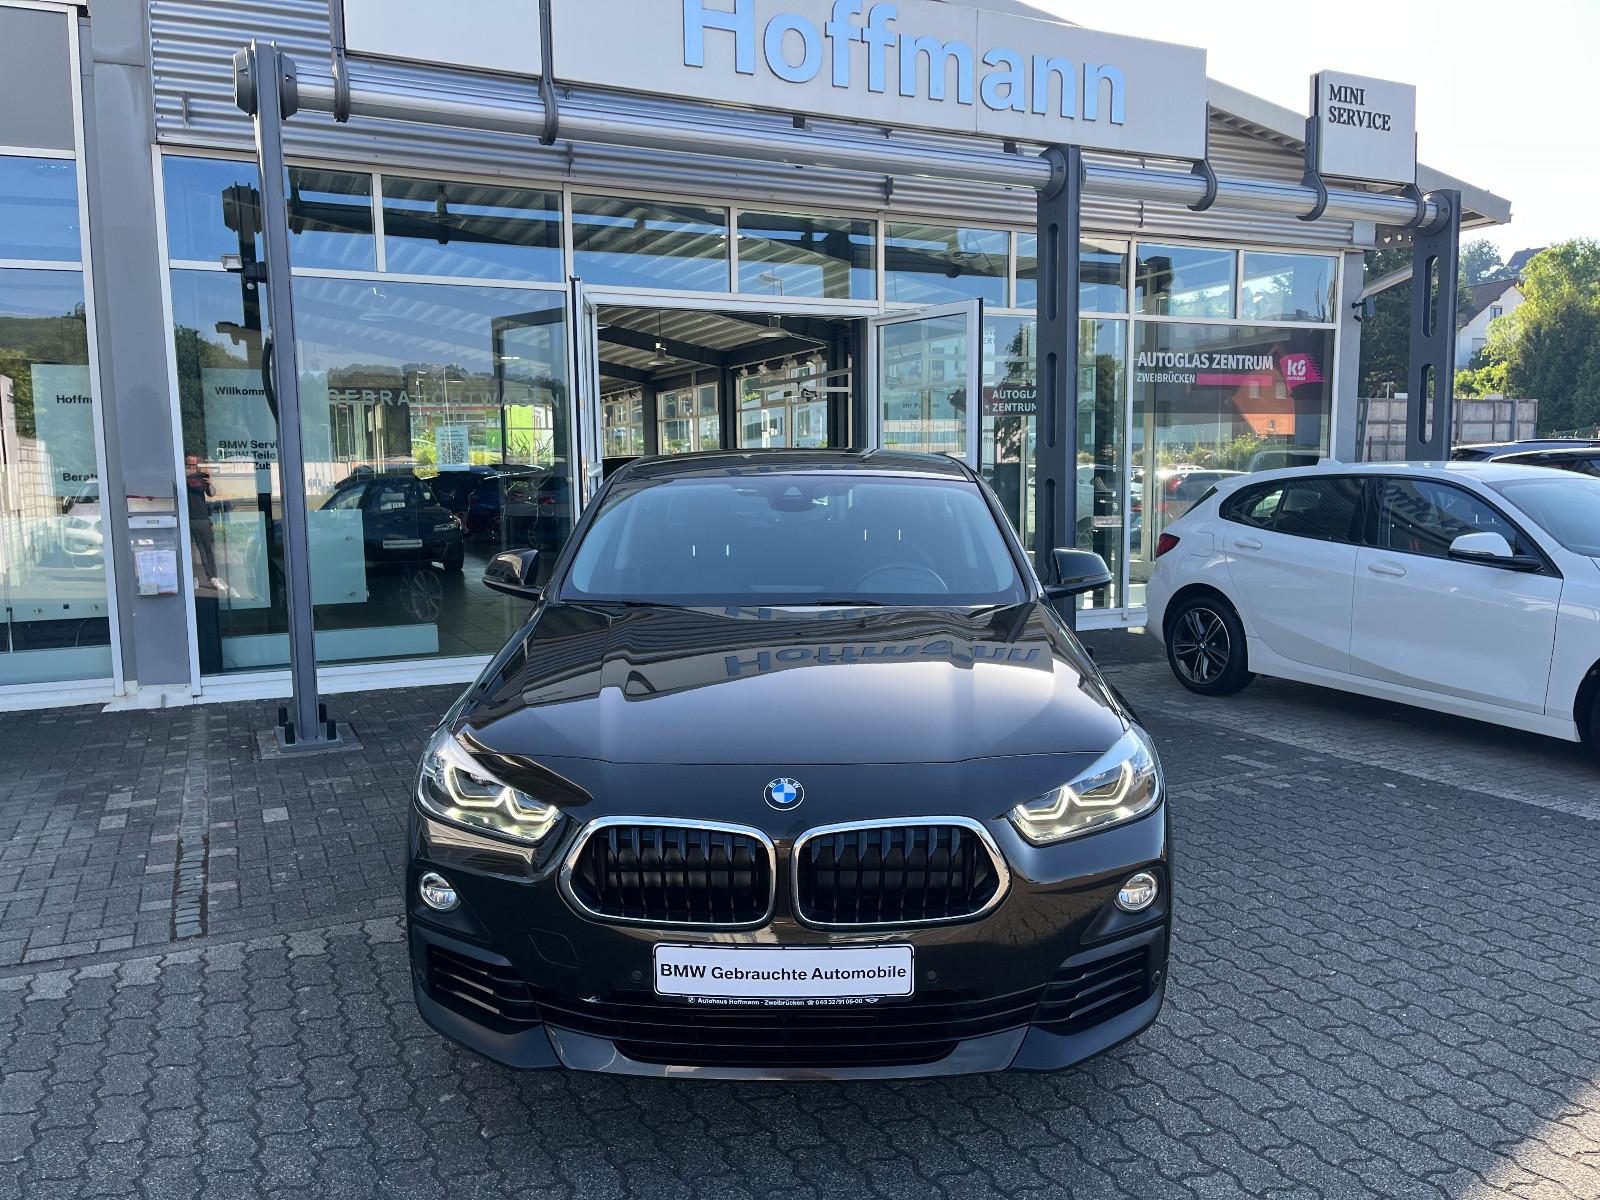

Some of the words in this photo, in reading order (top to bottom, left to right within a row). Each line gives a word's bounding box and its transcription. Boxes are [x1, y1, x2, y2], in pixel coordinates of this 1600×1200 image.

[683, 0, 1126, 125] Hoffmann
[1328, 83, 1365, 106] MINI
[1328, 105, 1391, 131] SERVICE
[1137, 351, 1210, 369] AUTOGLAS
[1211, 353, 1273, 370] ZENTRUM
[1136, 371, 1196, 383] ZWEIBRÜCKEN
[219, 441, 248, 449] BMW
[660, 963, 707, 979] BMW
[711, 966, 808, 981] Gebrauchte
[811, 965, 907, 980] Automobile
[697, 997, 728, 1005] Autohaus
